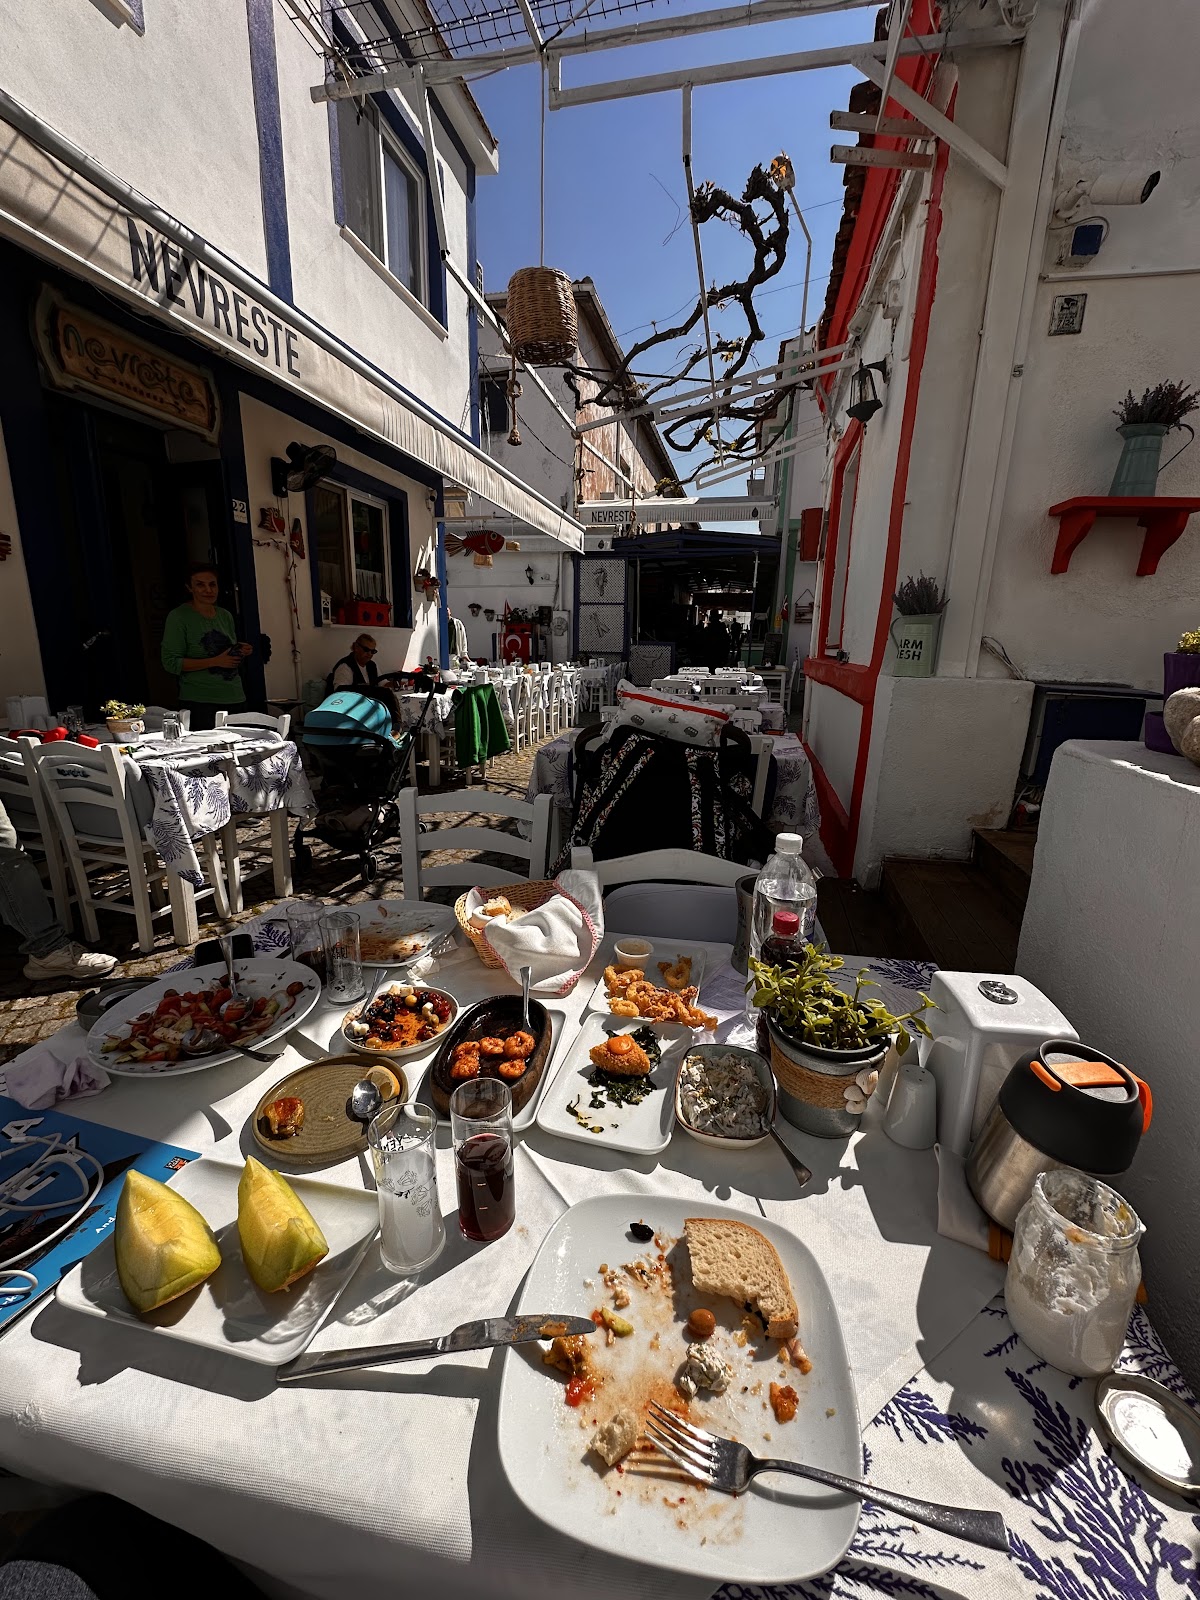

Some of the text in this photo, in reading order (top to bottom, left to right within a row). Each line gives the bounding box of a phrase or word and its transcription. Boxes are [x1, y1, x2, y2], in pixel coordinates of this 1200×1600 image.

[127, 216, 301, 379] NEVRESTE
[1012, 364, 1024, 378] 5
[897, 649, 922, 660] ESH
